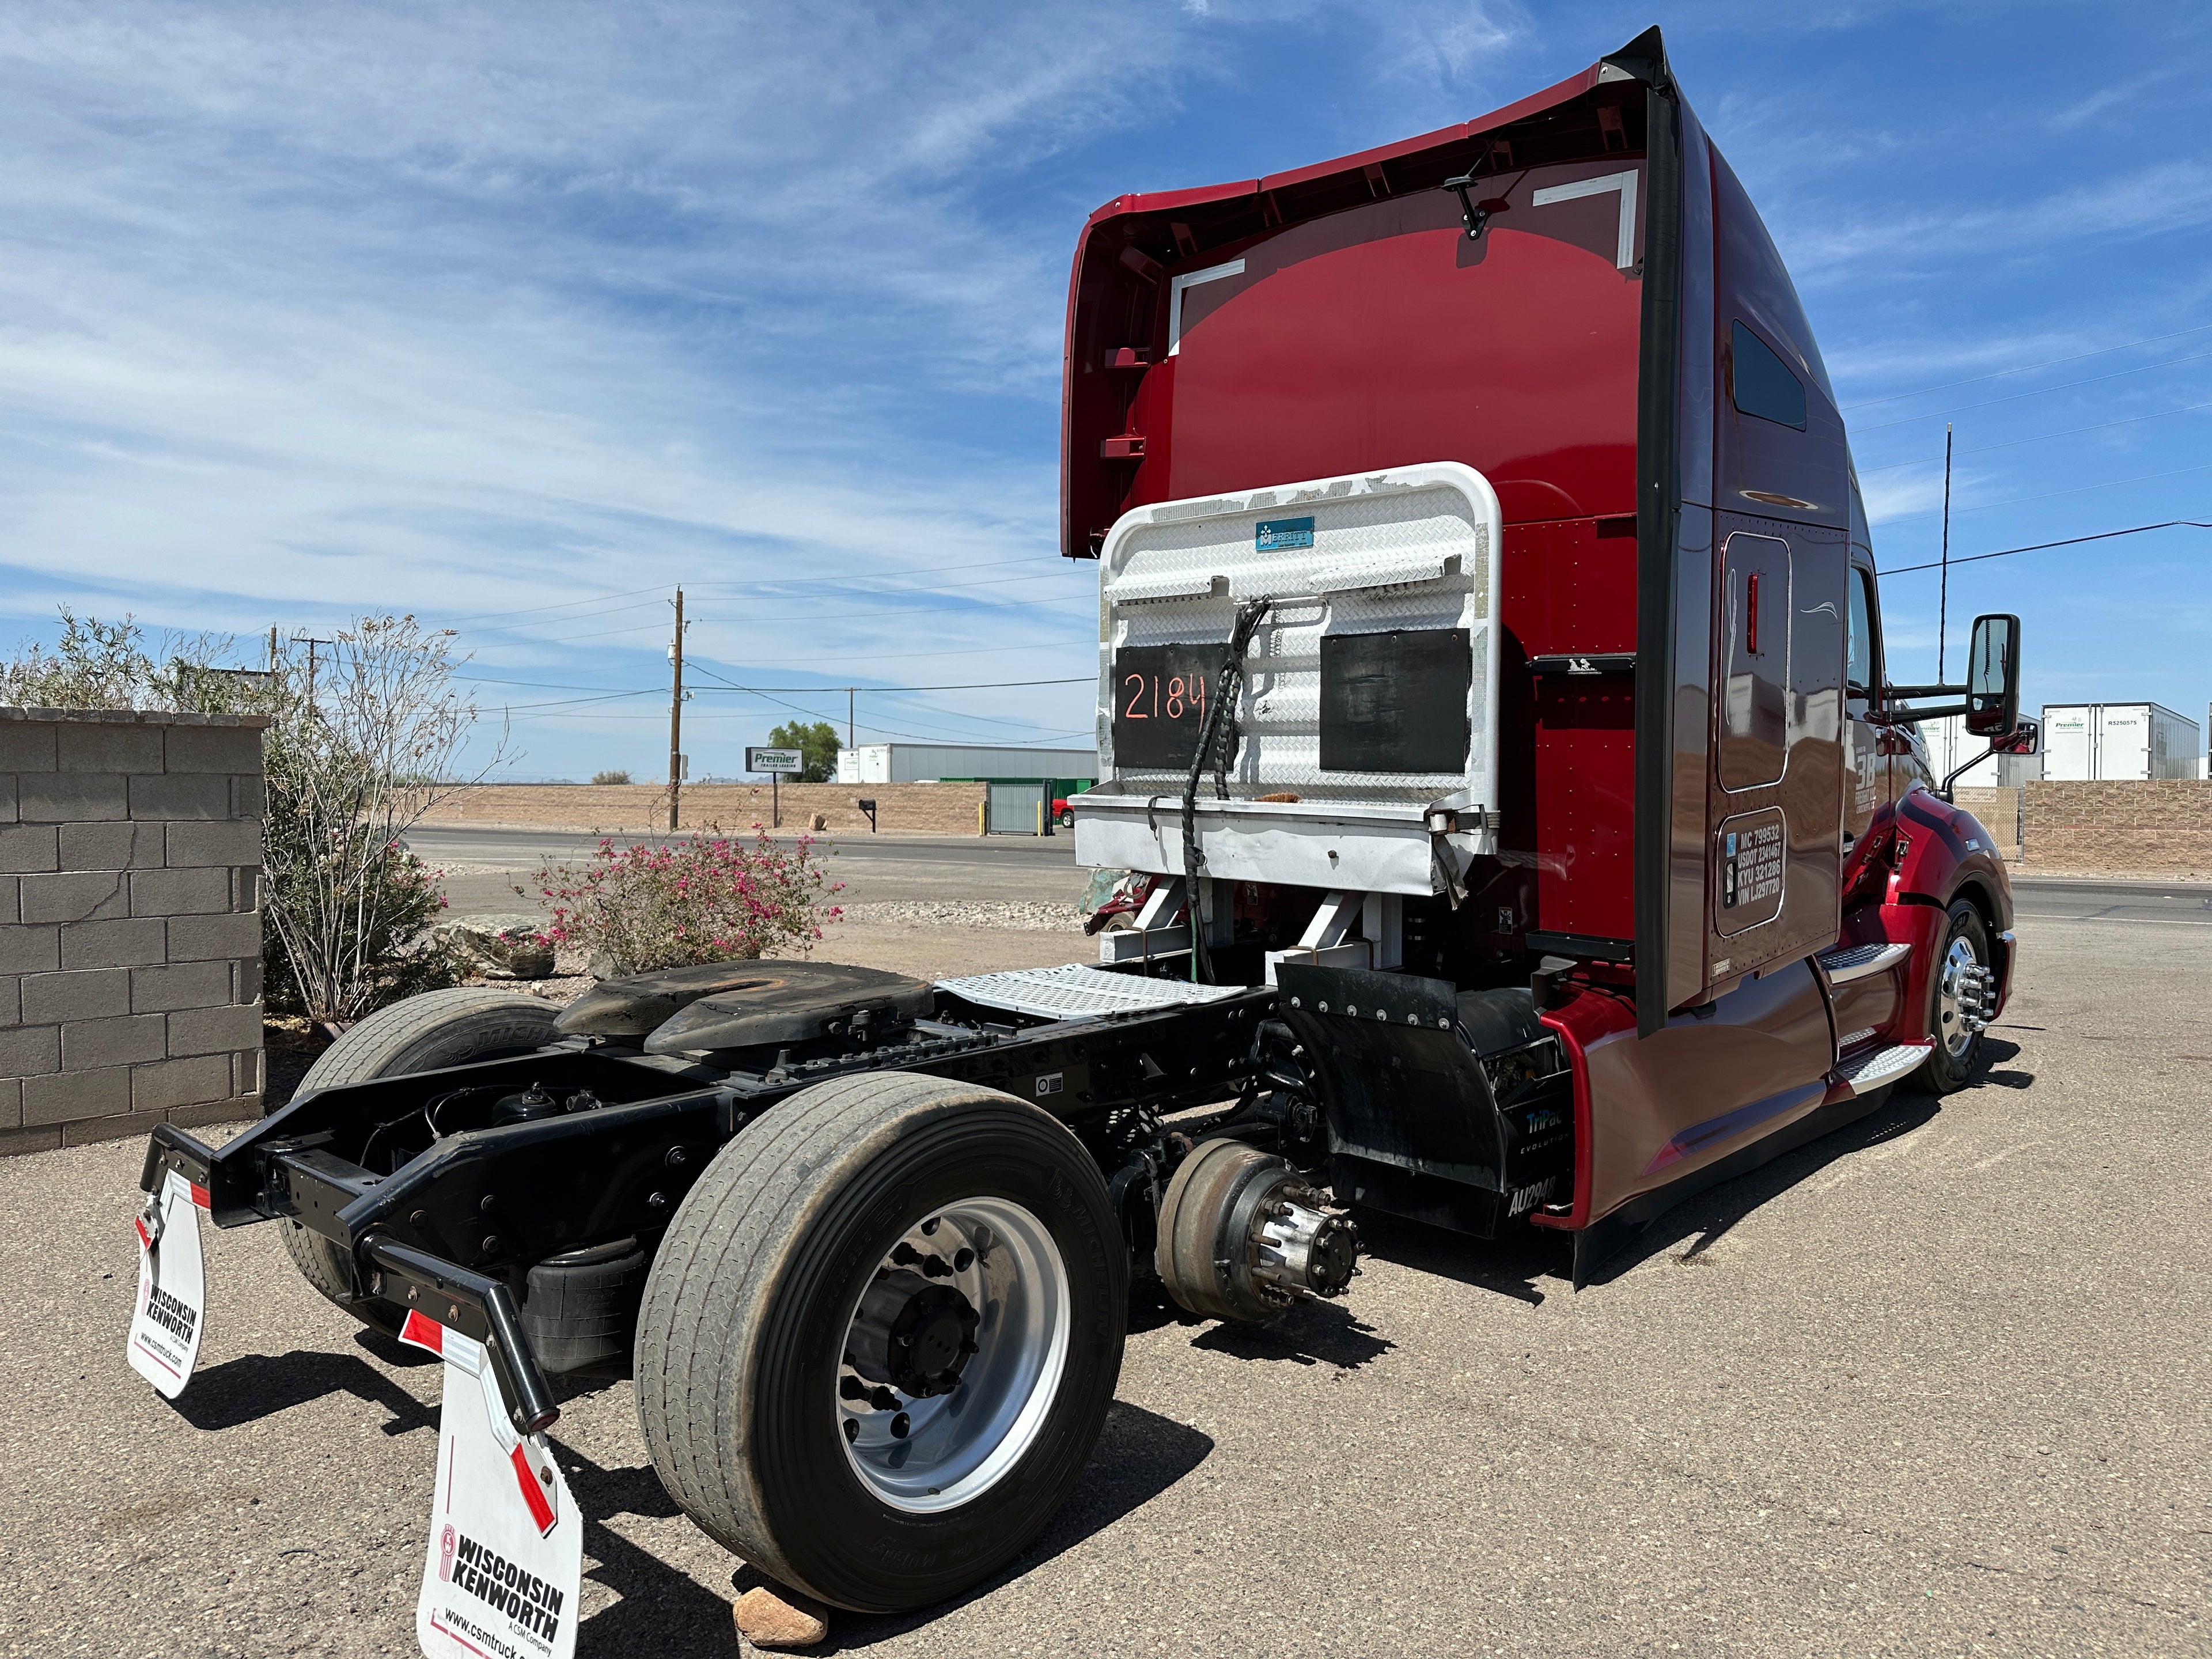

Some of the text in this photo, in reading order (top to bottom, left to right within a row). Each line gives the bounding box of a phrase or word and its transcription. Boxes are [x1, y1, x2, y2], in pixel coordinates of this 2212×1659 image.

[1260, 531, 1307, 546] MERRITT
[1125, 673, 1205, 734] 2184
[755, 753, 797, 763] Premier
[1856, 752, 1876, 790] 3B
[1741, 831, 1752, 850] MC
[1754, 824, 1779, 846] 799532
[1738, 848, 1758, 869] USDOT
[1758, 842, 1781, 863] 2341467
[1737, 859, 1781, 888] KYU 321286
[1738, 877, 1779, 906] VIN LJ297720
[1527, 1109, 1562, 1134] TriPac
[1521, 1133, 1570, 1154] EVOLUTION
[1508, 1176, 1556, 1217] AU2948
[146, 1301, 194, 1344] KENWORTH
[150, 1284, 197, 1327] WISCONSIN
[141, 1332, 182, 1368] www.csmtruck.com
[458, 1534, 564, 1616] WISCONSIN
[452, 1559, 559, 1643] KENWORTH
[445, 1607, 525, 1659] www.csmtruck
[508, 1622, 552, 1657] A CSM Company
